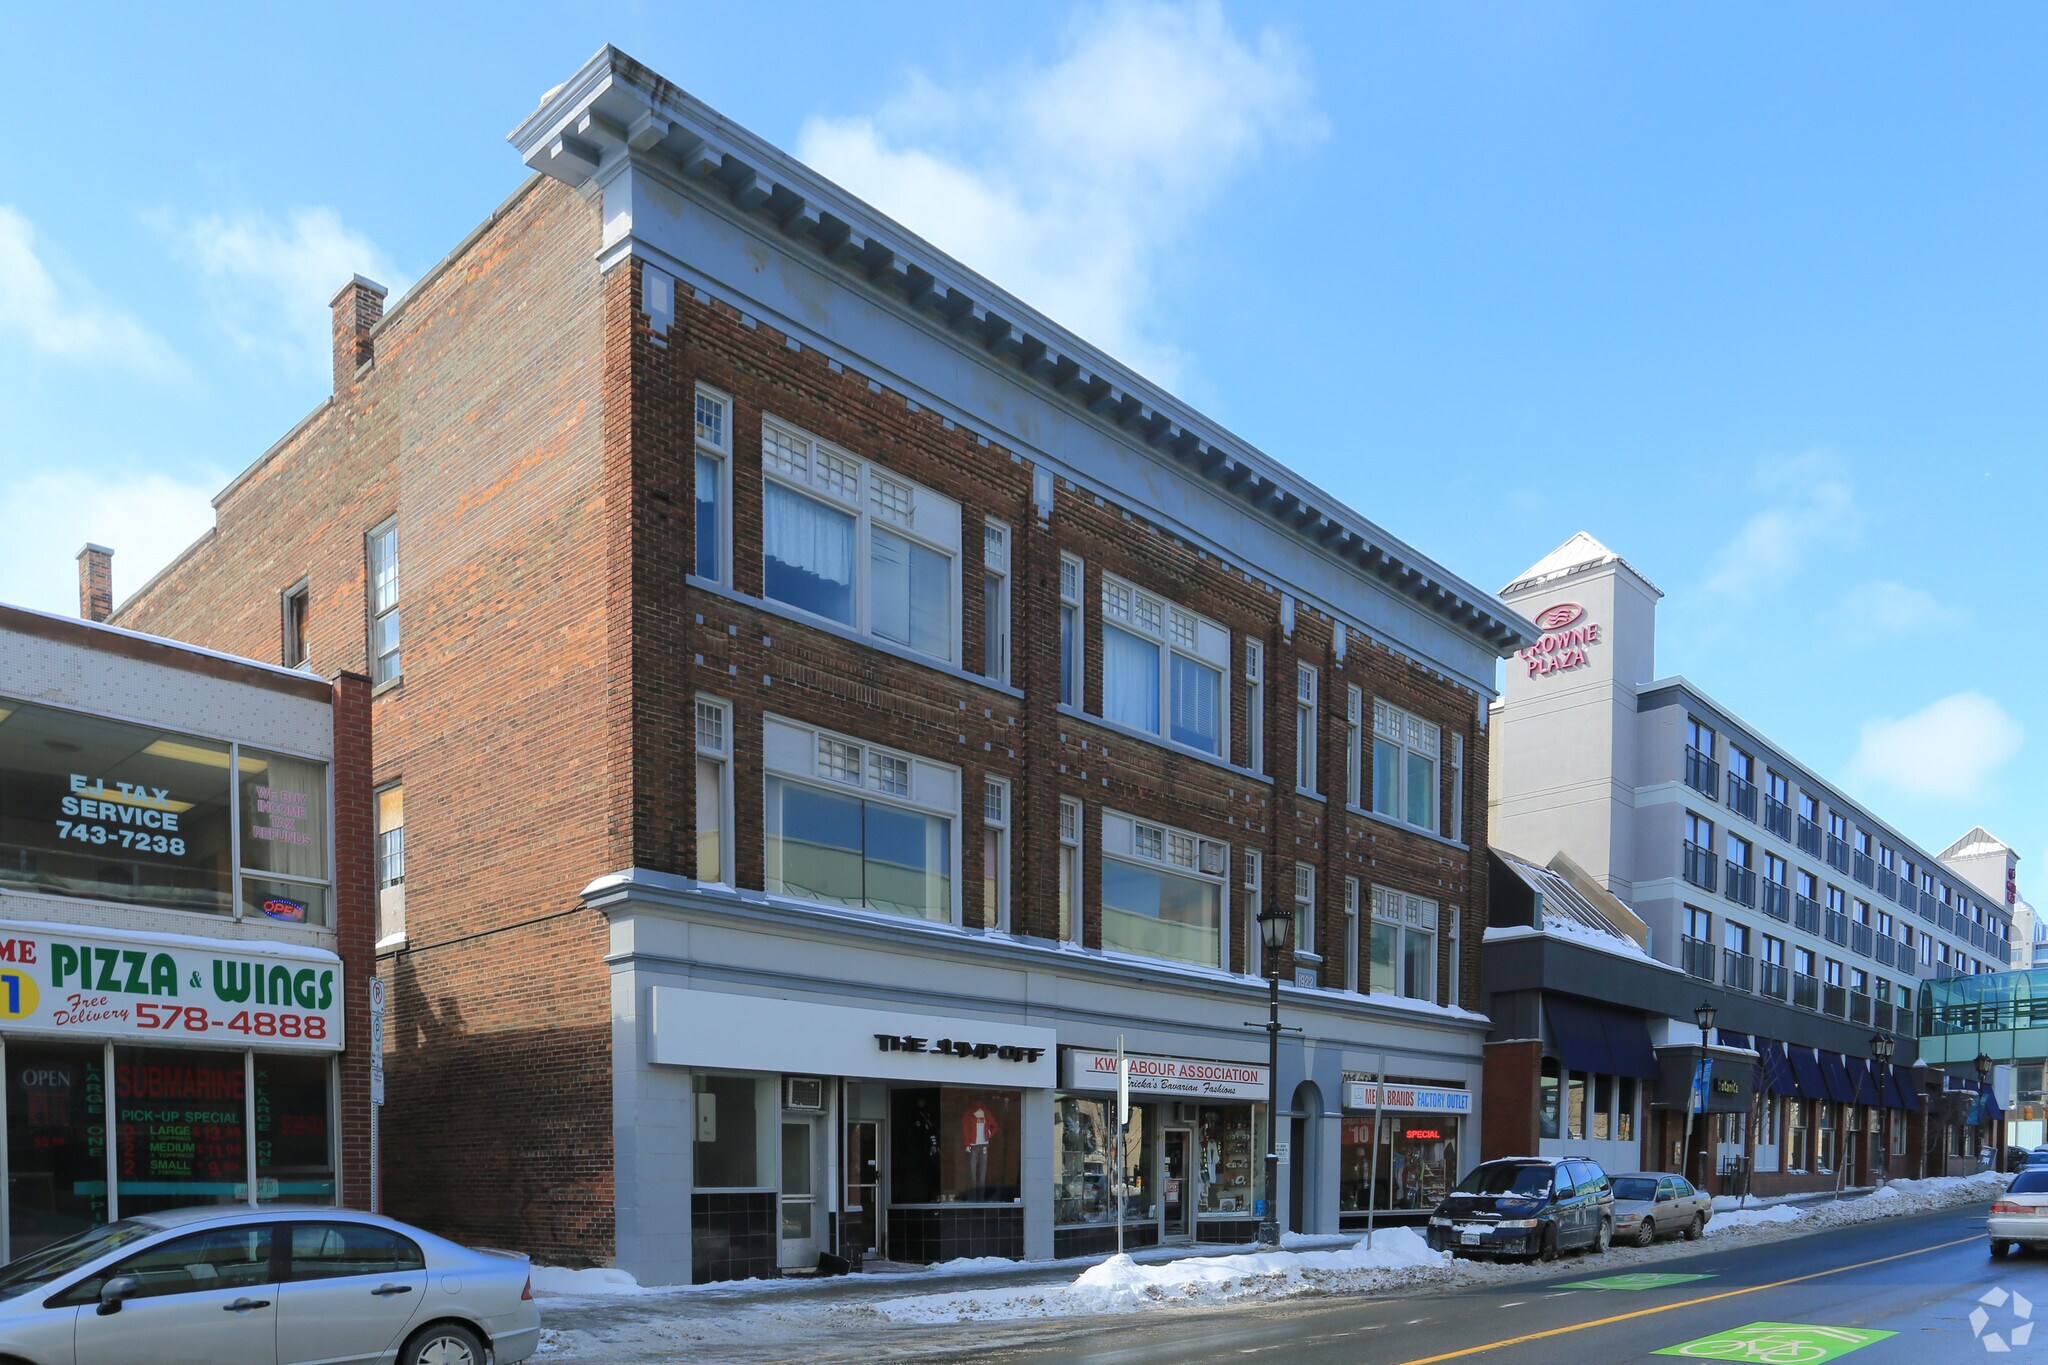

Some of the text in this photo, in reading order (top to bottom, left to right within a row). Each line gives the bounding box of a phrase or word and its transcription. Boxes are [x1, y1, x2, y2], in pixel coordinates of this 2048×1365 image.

[1527, 649, 1586, 678] PLAZA
[70, 774, 169, 807] EJ TAX
[256, 785, 307, 805] WE BUY
[61, 796, 178, 832] SERVICE
[257, 801, 307, 819] INCOME
[269, 815, 295, 830] TAX
[56, 820, 186, 856] 743-7238
[253, 827, 312, 846] REFUNDS
[264, 901, 303, 919] OPEN
[51, 943, 333, 1010] PIZZA & WINGS
[1298, 974, 1314, 989] 1922
[67, 993, 109, 1012] Free
[53, 1006, 129, 1026] Delivery
[136, 1003, 327, 1039] 578-4888
[873, 1034, 929, 1053] THE
[997, 1045, 1047, 1063] OFF
[22, 1069, 70, 1087] OPEN
[1094, 1056, 1258, 1082] KW ABOUR ASSOCIATION
[117, 1064, 245, 1100] SUBMARINE
[1160, 1078, 1199, 1092] Bavarian
[1203, 1082, 1236, 1095] Fashions
[1365, 1088, 1469, 1109] MEA BRANDS FACTORY OUTLET
[86, 1061, 104, 1157] LARGE ONE
[121, 1109, 240, 1124] PICK-UP SPECIAL
[149, 1125, 192, 1136] LARGE
[1406, 1130, 1440, 1139] SPECIAL
[149, 1143, 195, 1153] MEDIUM
[122, 1159, 135, 1175] 2
[150, 1160, 192, 1170] SMALL
